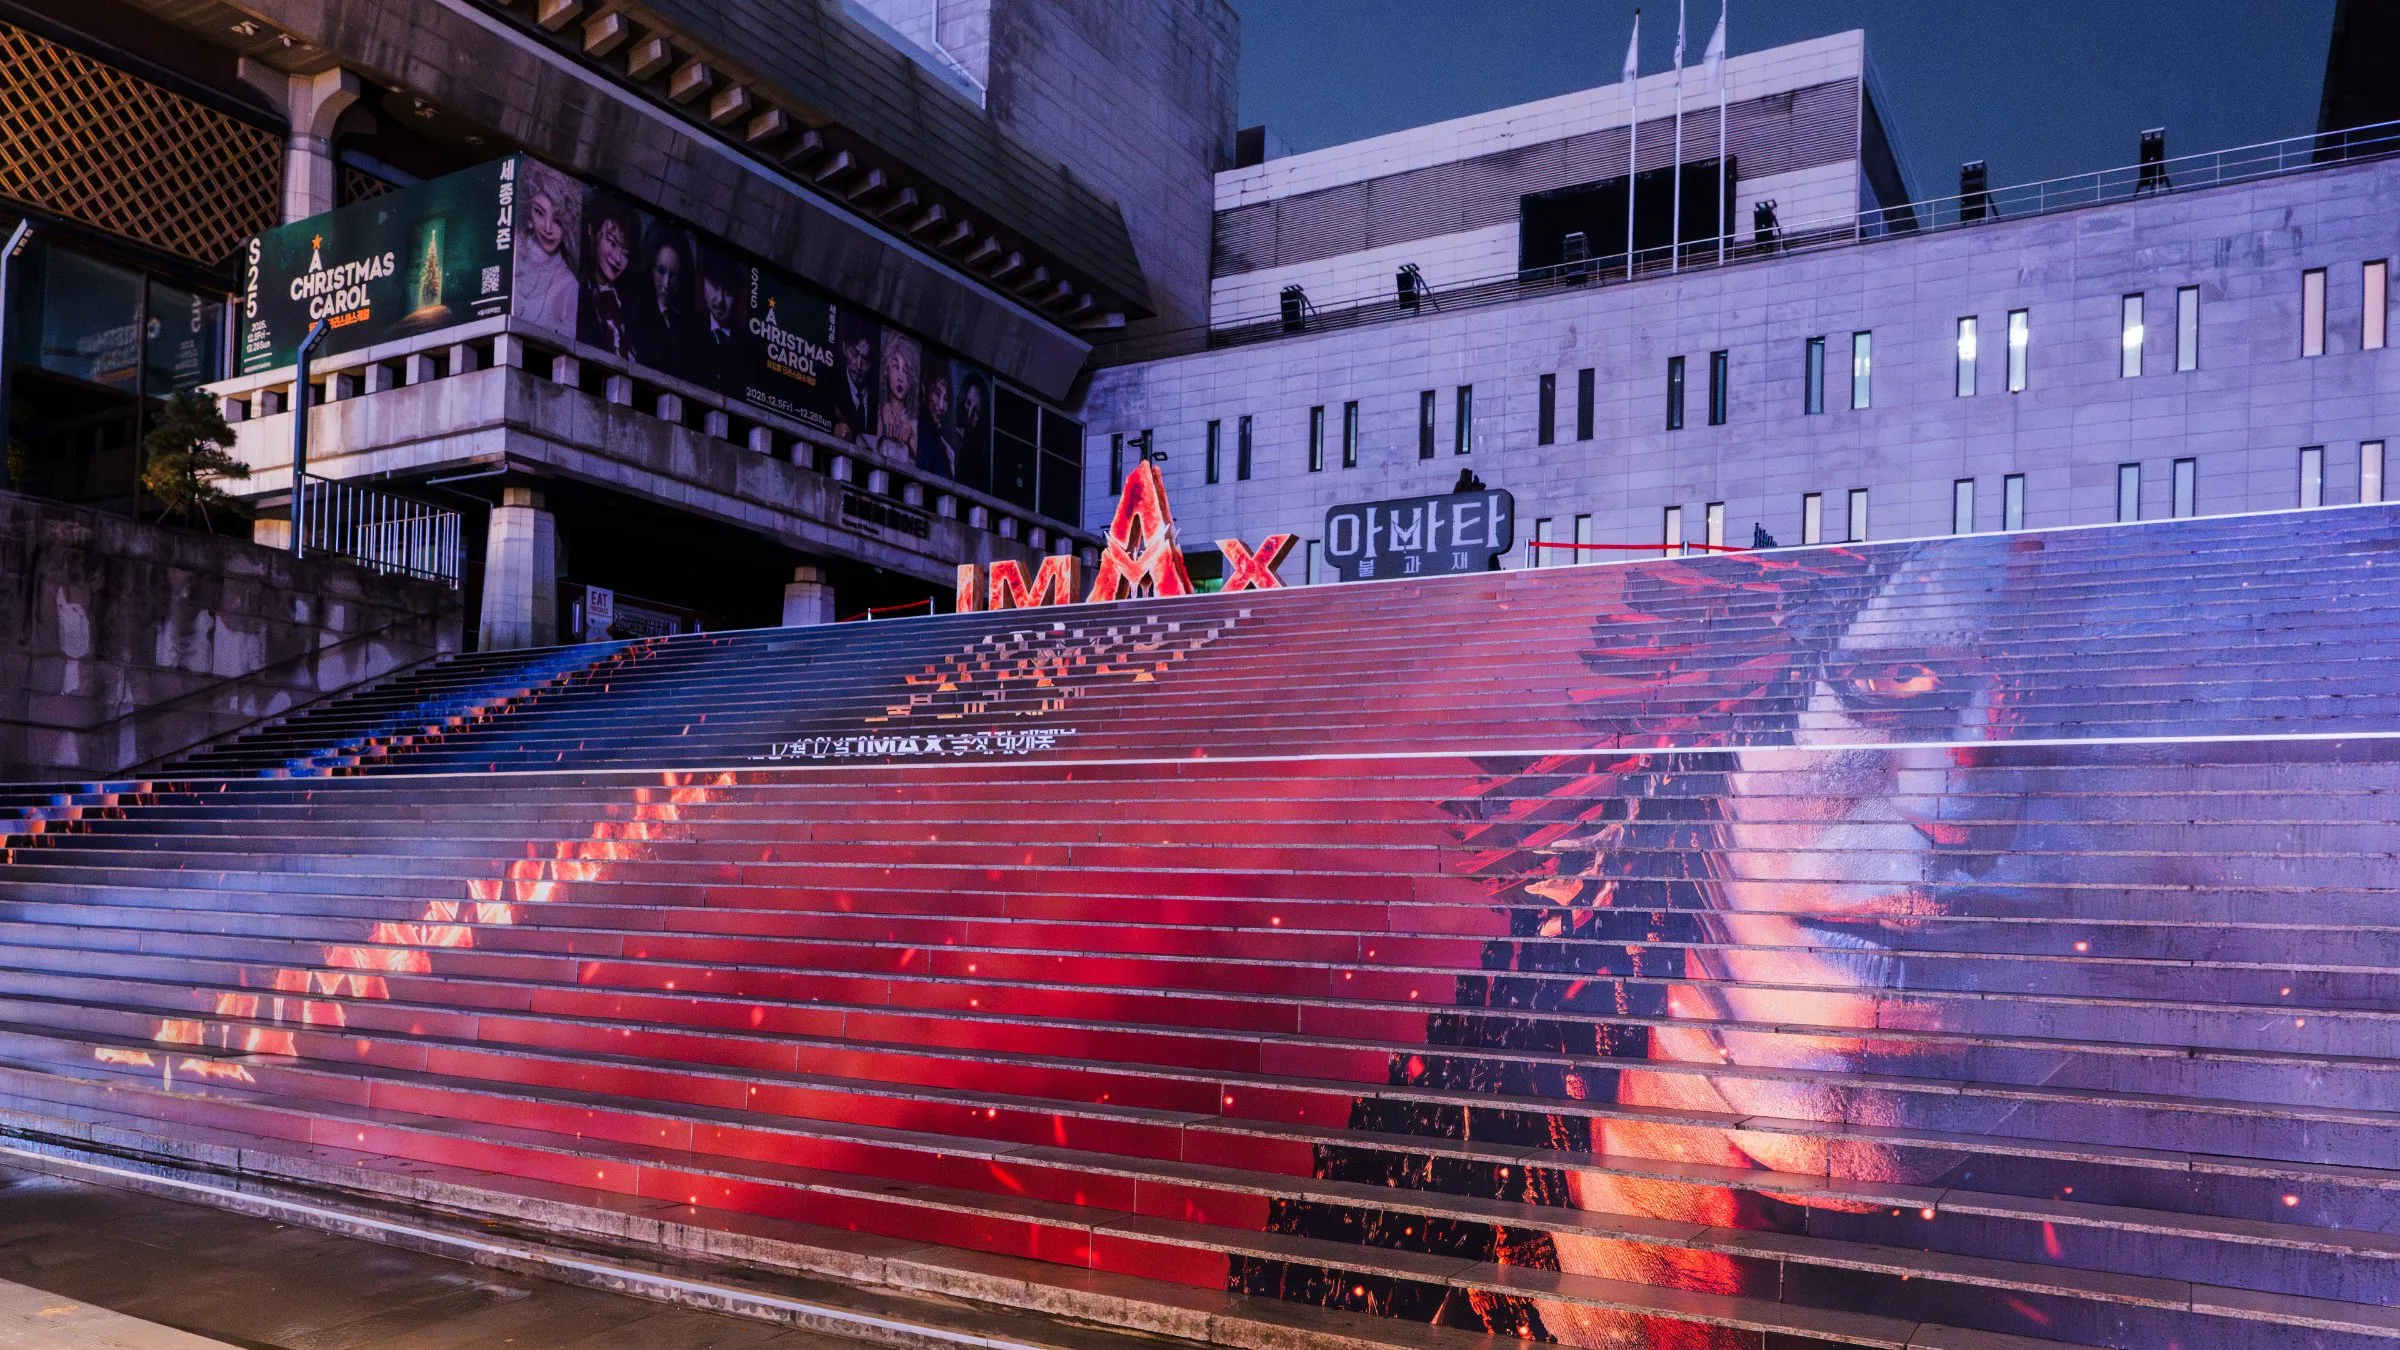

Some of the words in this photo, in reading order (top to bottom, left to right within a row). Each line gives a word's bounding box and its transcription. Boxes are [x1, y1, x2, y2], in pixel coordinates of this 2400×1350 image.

[496, 158, 515, 251] 세종시즌
[246, 237, 261, 318] S25
[290, 251, 395, 301] CHRISTMAS
[308, 249, 323, 273] A
[309, 284, 371, 320] CAROL
[765, 307, 777, 326] A
[749, 317, 834, 368] CHRISTMAS
[767, 343, 817, 377] CAROL
[956, 459, 1298, 613] IMAX
[1329, 495, 1506, 558] 아바타
[591, 592, 608, 607] EAT
